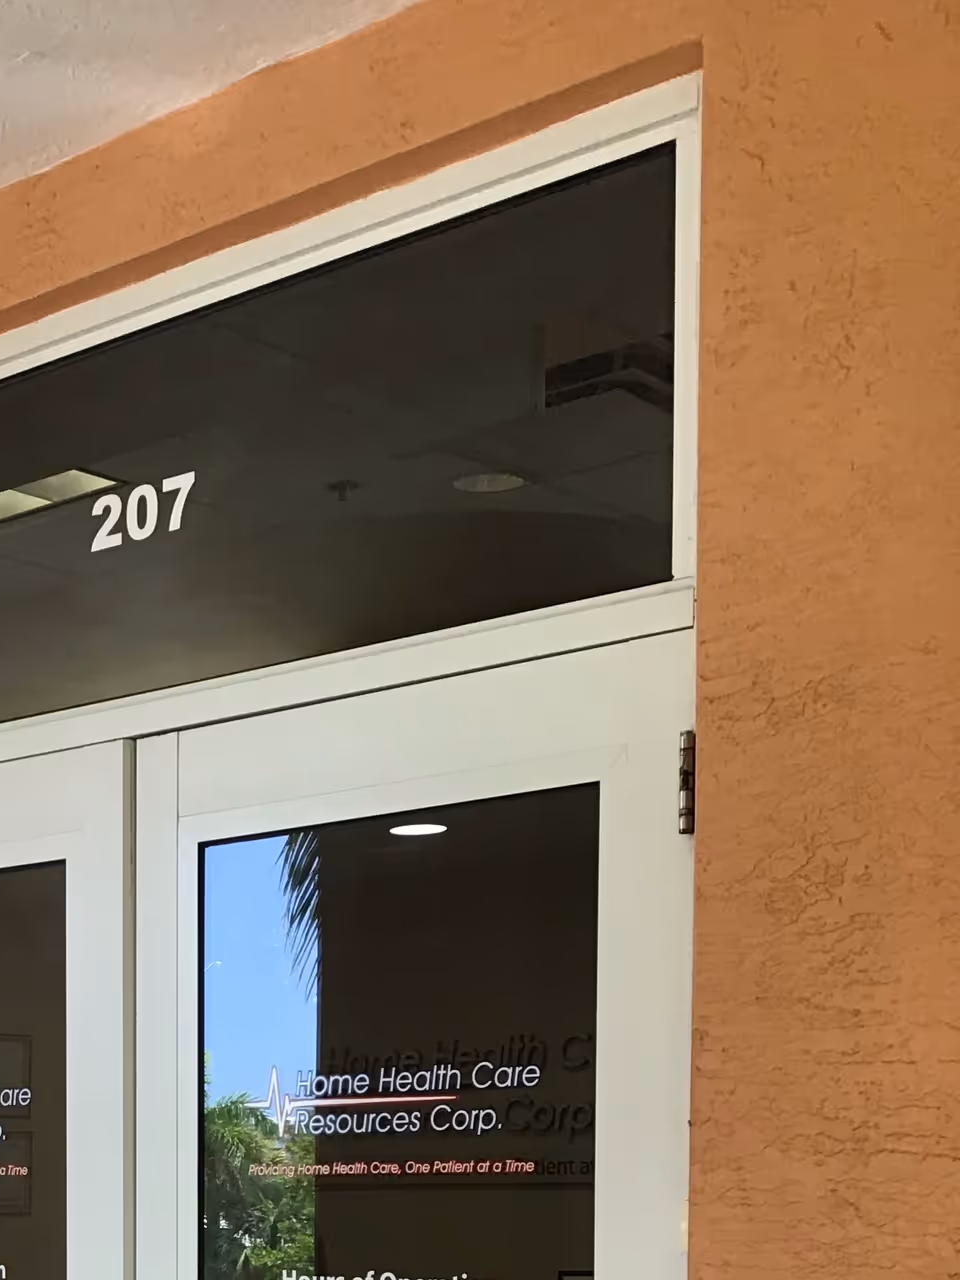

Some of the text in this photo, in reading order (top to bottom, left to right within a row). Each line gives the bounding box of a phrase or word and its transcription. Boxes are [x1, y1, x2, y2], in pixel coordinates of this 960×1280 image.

[91, 471, 195, 552] 207
[295, 1061, 541, 1098] Home Health Care
[294, 1104, 502, 1136] Resources Corp.
[0, 1166, 6, 1176] a
[8, 1164, 28, 1176] Time
[248, 1160, 535, 1177] Providing Home Health Care, One Patient at a Time
